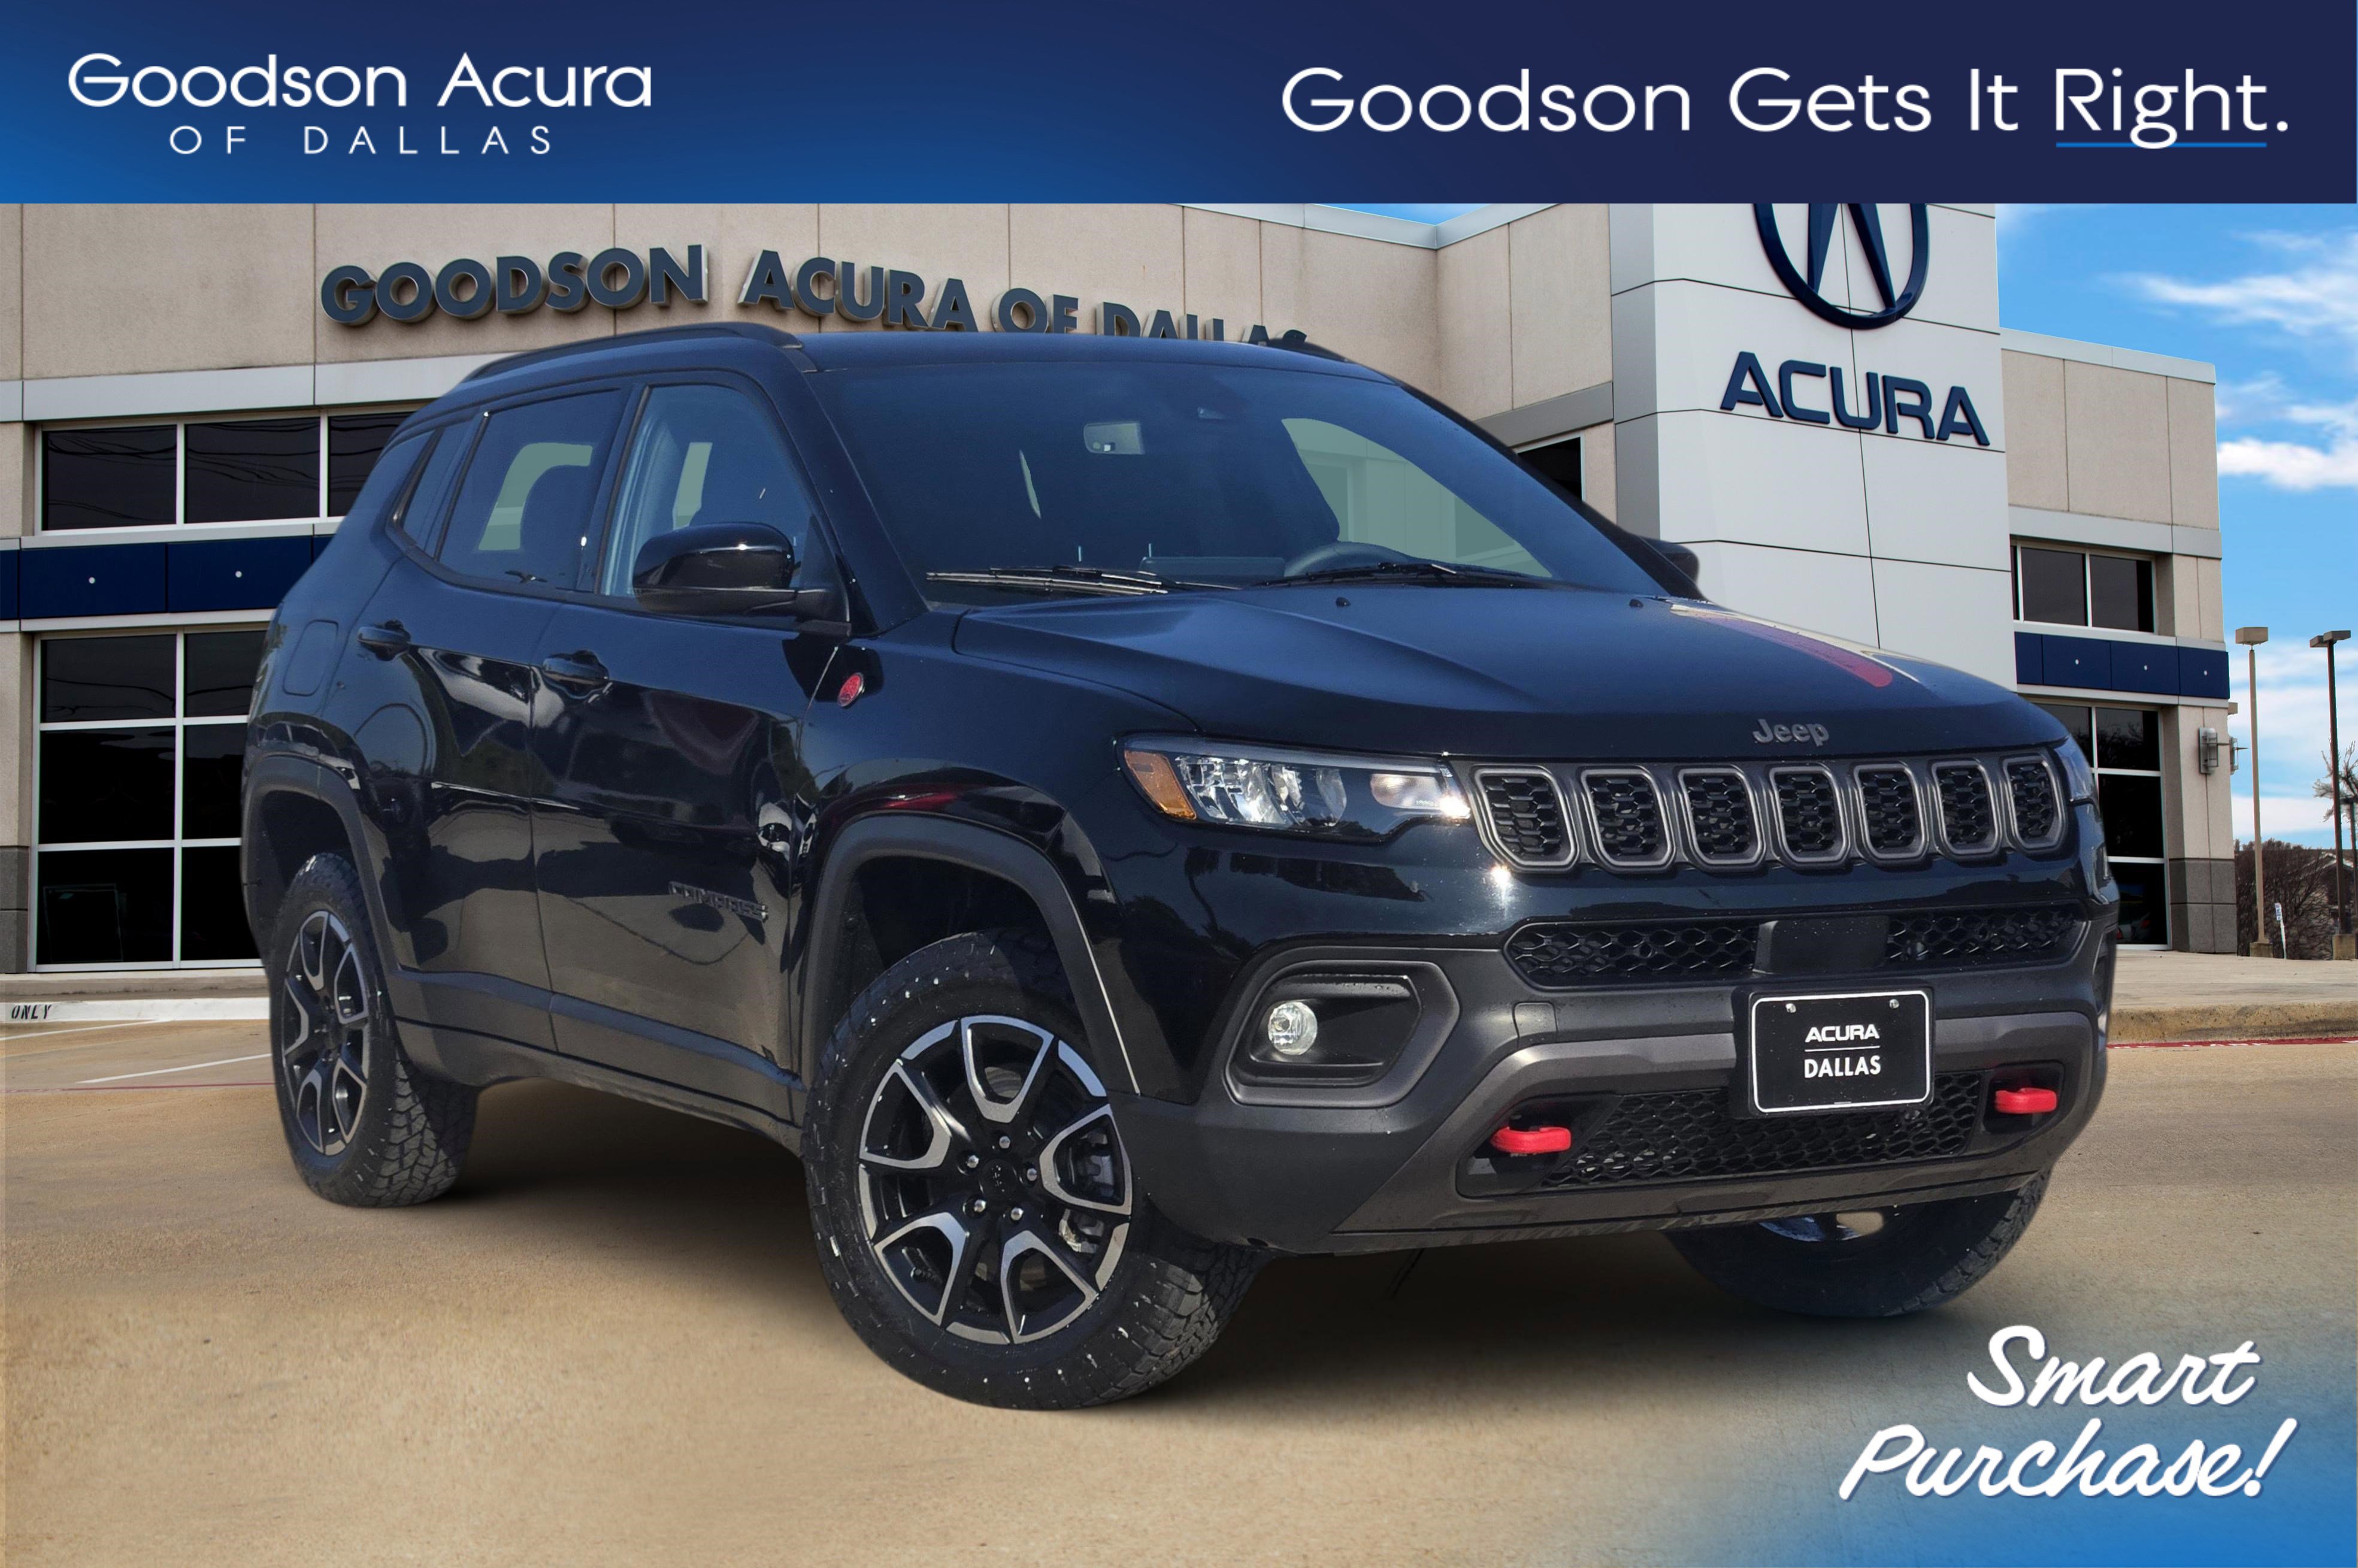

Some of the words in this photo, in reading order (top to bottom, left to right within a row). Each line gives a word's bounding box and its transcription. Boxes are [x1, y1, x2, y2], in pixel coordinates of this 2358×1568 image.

[321, 244, 708, 326] GOODSON
[737, 249, 979, 332] ACURA
[991, 287, 1079, 334] OF
[1720, 351, 1990, 446] ACURA
[1752, 719, 1829, 747] Jeep
[11, 1004, 52, 1019] ONLY
[1805, 1024, 1880, 1043] ACURA
[1804, 1055, 1881, 1079] DALLAS
